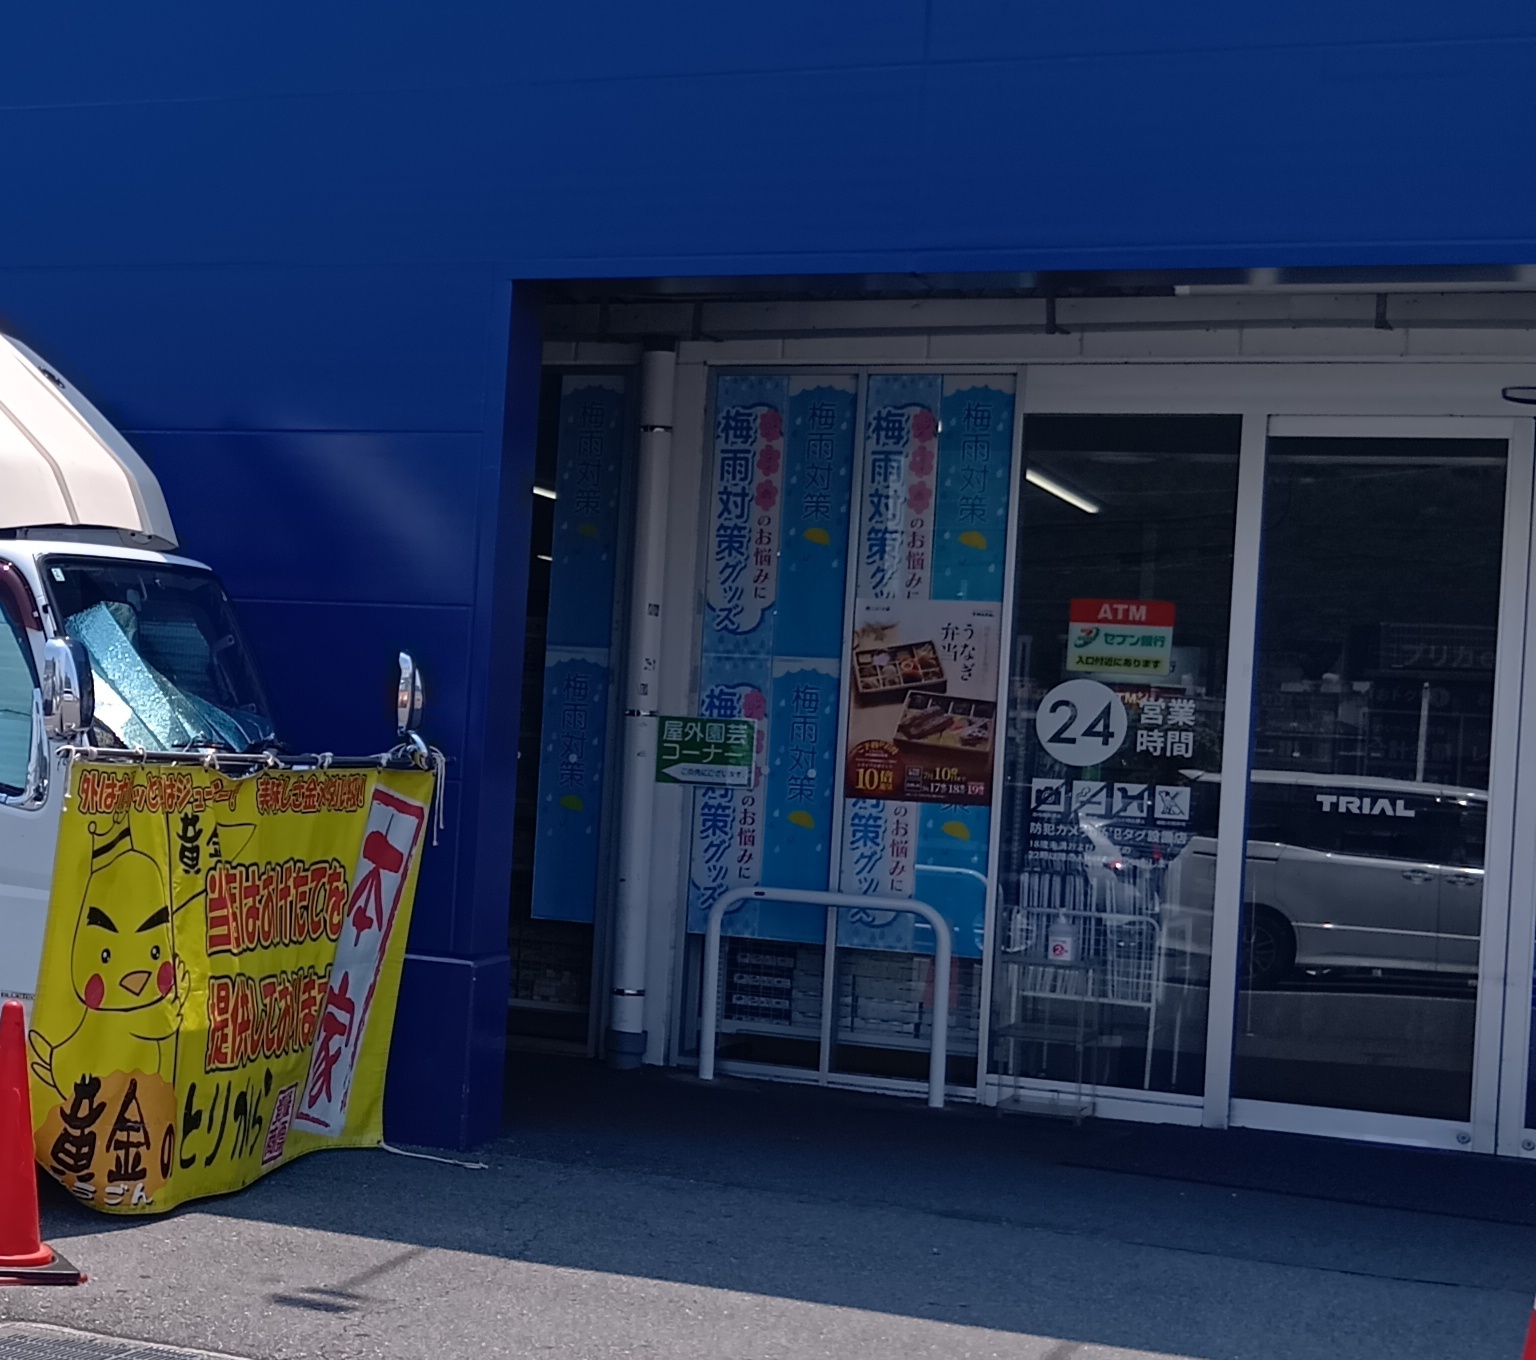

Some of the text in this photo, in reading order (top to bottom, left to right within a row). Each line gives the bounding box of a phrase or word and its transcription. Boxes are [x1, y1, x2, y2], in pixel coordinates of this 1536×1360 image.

[802, 401, 837, 522] 梅雨対策
[957, 400, 993, 524] 梅雨対策
[714, 408, 754, 632] 梅雨対策グッズ
[753, 515, 773, 600] のお悩みに
[1097, 603, 1148, 622] ATM
[941, 622, 960, 663] 弁当
[959, 623, 976, 682] うなぎ
[1076, 655, 1161, 670] 入口付近にあります
[1103, 632, 1166, 648] セブン銀行
[558, 672, 591, 789] 梅雨対策
[662, 720, 748, 746] 屋外園芸
[1046, 699, 1115, 746] 24
[1139, 697, 1196, 727] 営業
[662, 742, 744, 764] コーナー
[786, 683, 820, 803] 梅雨対策
[1135, 729, 1195, 759] 時間
[1316, 793, 1416, 818] TRIAL
[736, 794, 756, 880] のお悩みに
[889, 805, 909, 892] のお悩みに
